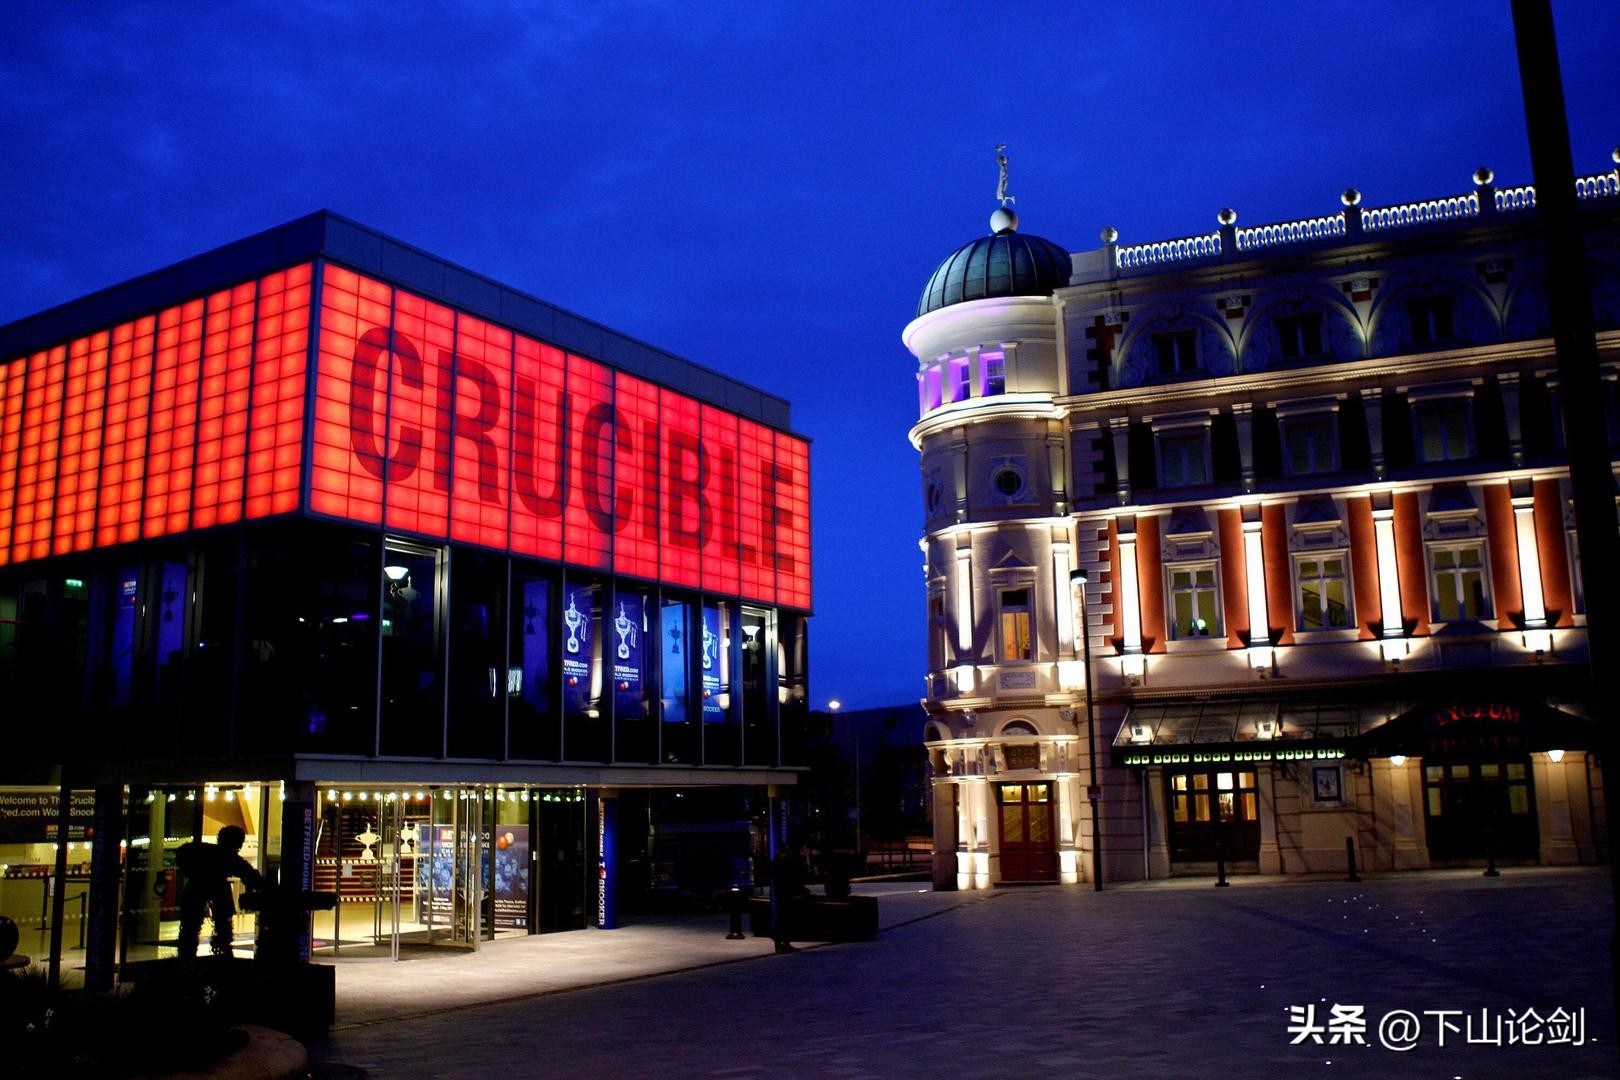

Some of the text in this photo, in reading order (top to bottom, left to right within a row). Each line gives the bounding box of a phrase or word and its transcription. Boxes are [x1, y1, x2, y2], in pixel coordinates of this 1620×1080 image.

[351, 326, 795, 573] CRUCIBLE
[39, 796, 48, 806] to
[50, 796, 61, 806] Th
[42, 807, 60, 817] Wor
[302, 808, 312, 894] BETFRED MOBIL
[598, 878, 606, 926] SNOOKER
